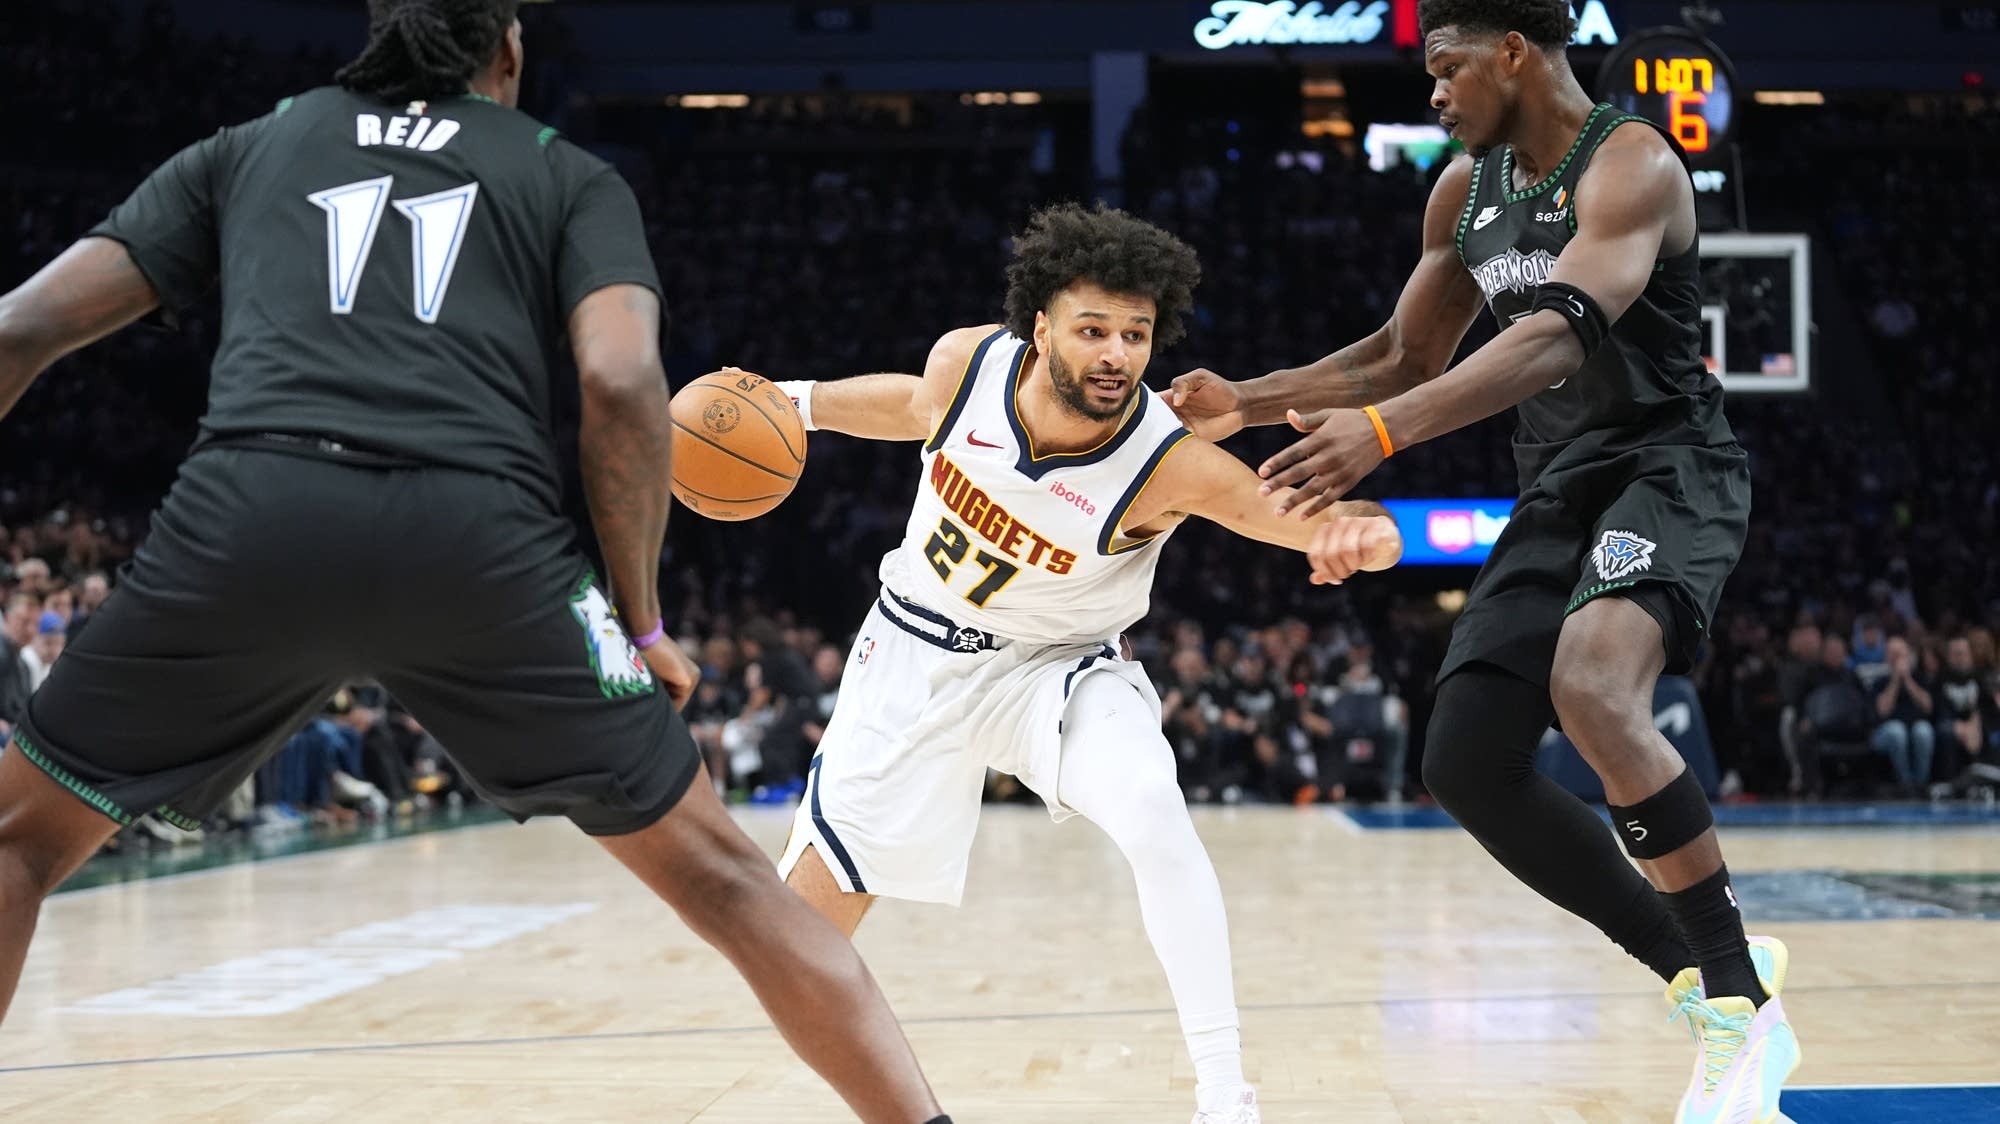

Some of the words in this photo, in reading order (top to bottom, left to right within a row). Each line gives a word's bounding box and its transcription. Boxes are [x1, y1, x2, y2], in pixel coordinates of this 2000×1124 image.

[1635, 58, 1713, 94] 11:07
[356, 113, 461, 151] REID
[1669, 90, 1709, 153] 6
[306, 174, 480, 324] 11
[929, 450, 1078, 575] NUGGETS
[1050, 481, 1096, 515] ibotta
[923, 516, 1021, 609] 27
[1626, 820, 1648, 841] 5
